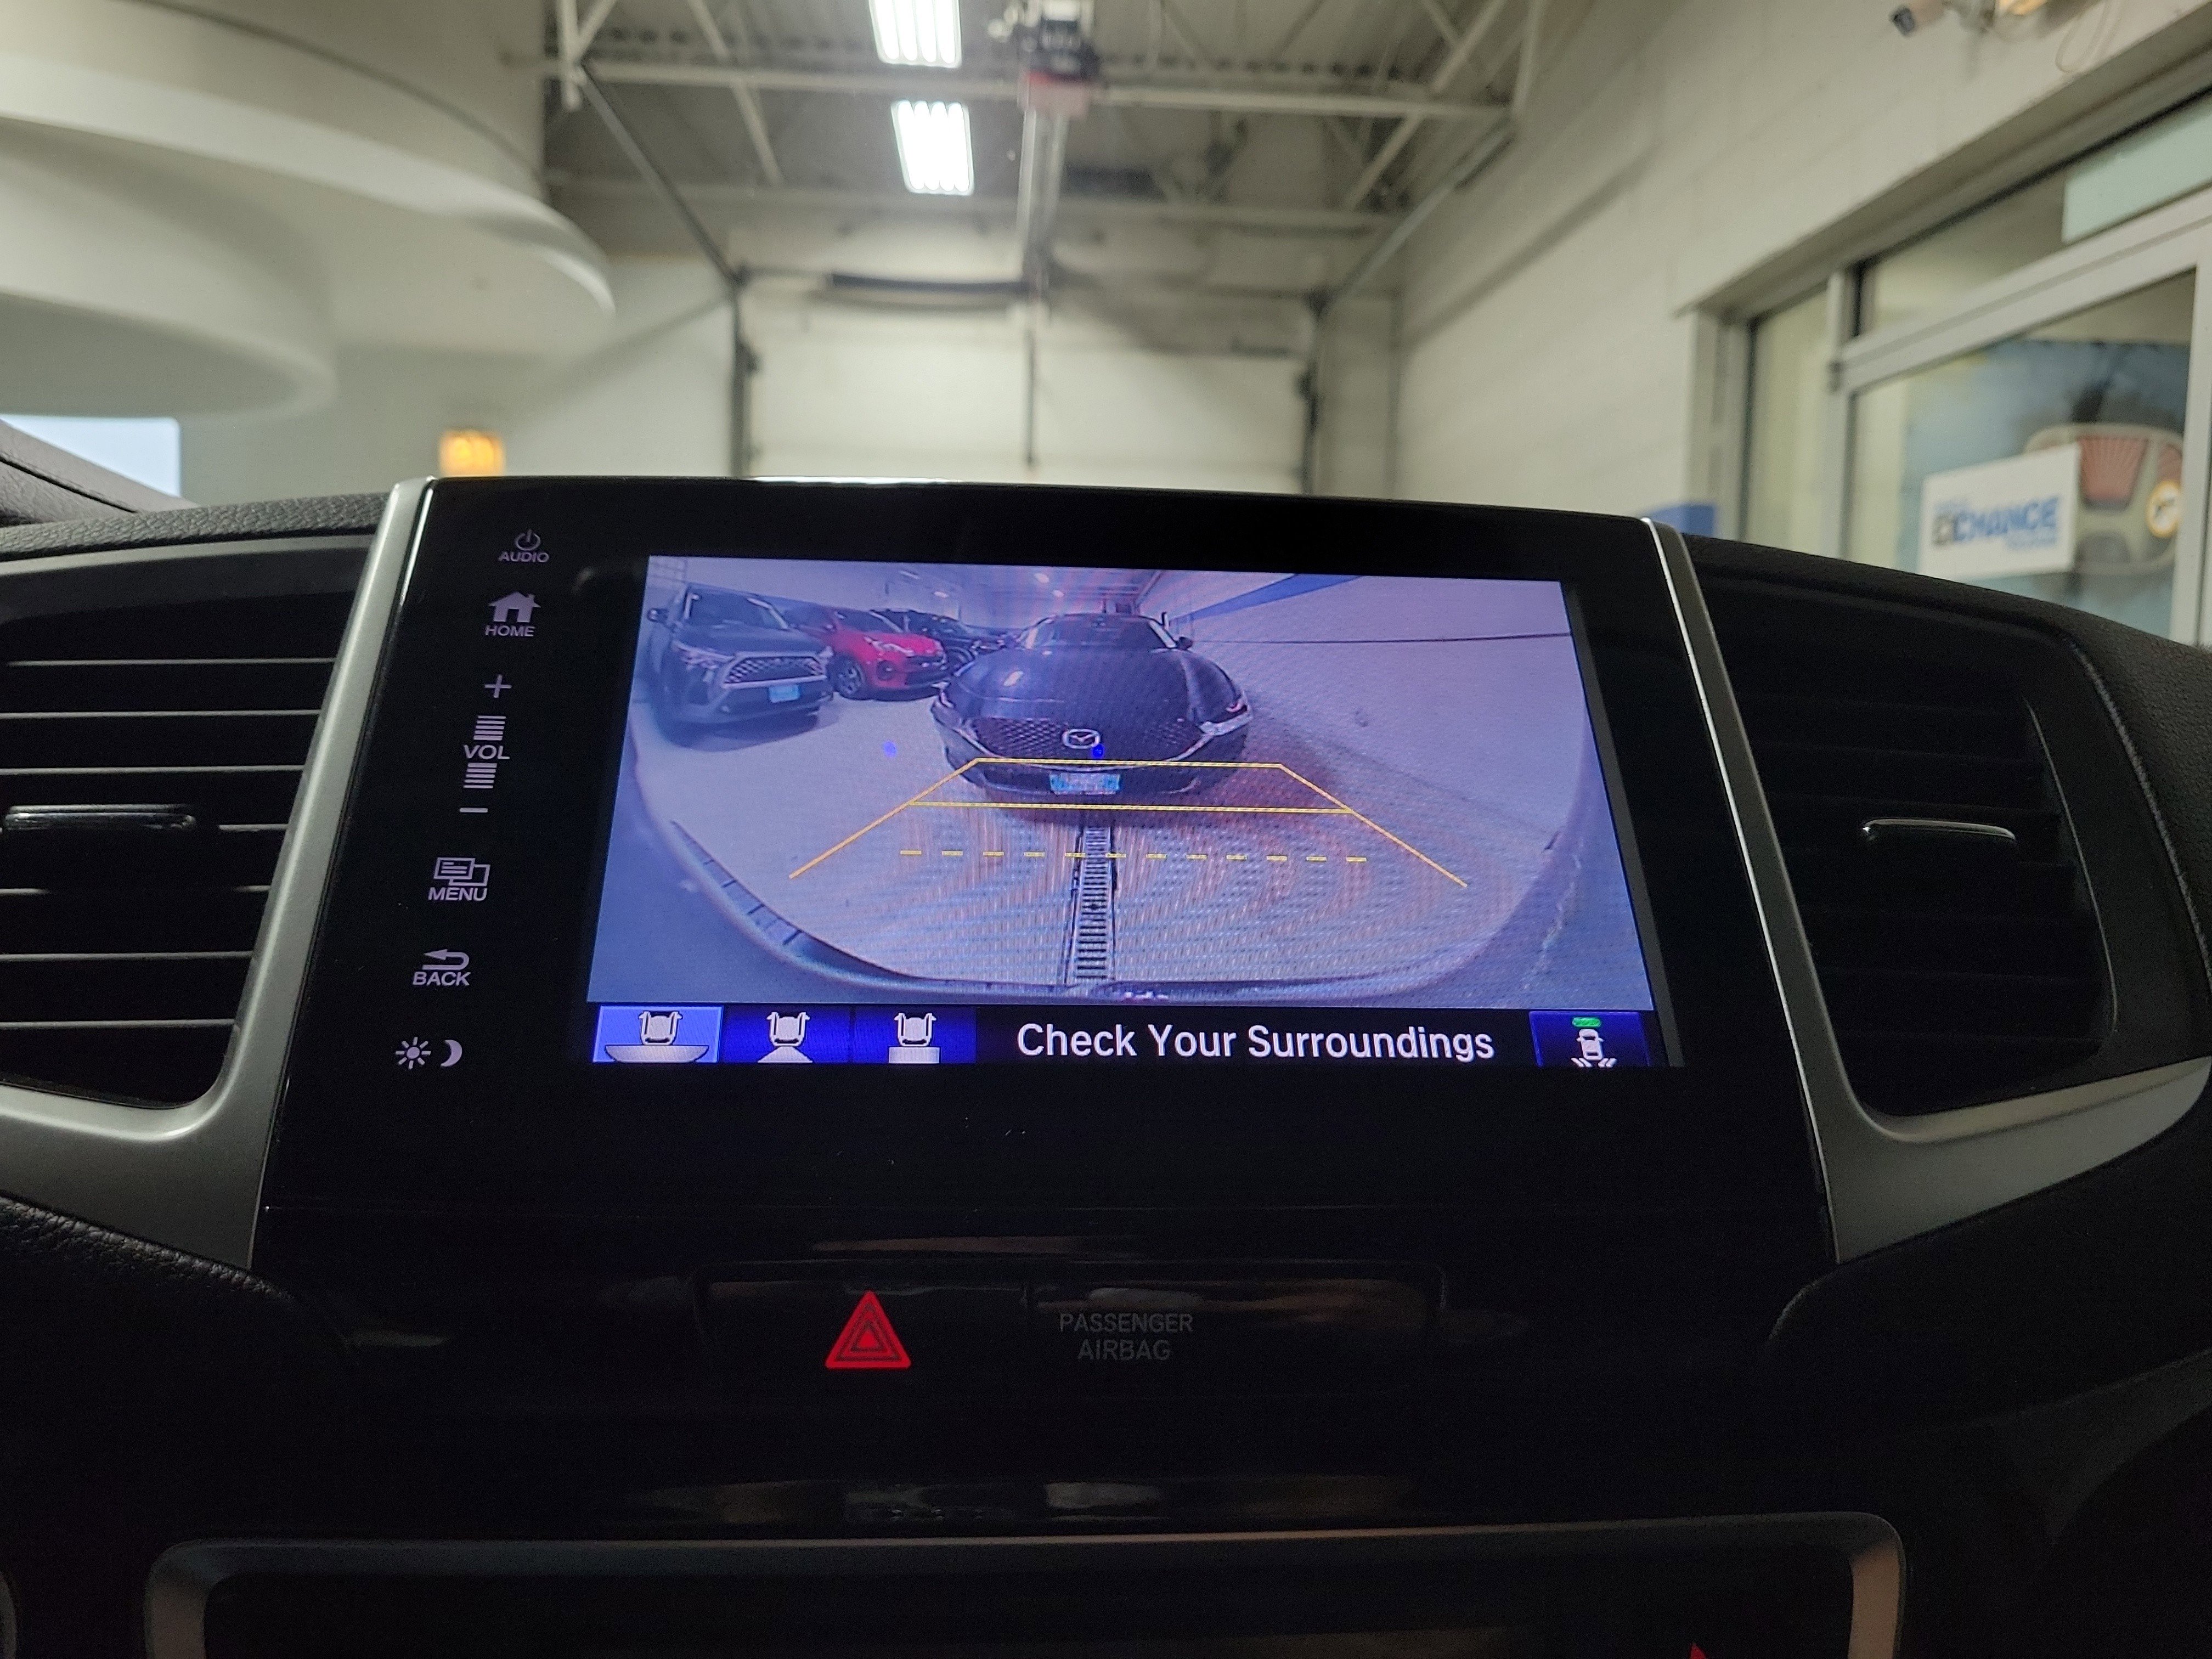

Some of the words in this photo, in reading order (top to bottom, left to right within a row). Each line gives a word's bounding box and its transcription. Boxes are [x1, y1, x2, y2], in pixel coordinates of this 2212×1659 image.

[499, 552, 549, 562] AUDIO
[485, 625, 535, 636] HOME
[464, 745, 510, 759] VOL
[428, 887, 488, 901] MENU
[413, 972, 471, 986] BACK
[1017, 1023, 1136, 1056] Check
[1148, 1024, 1237, 1057] Your
[1249, 1025, 1494, 1062] Surroundings
[1059, 1313, 1193, 1333] PASSENGER
[1077, 1339, 1171, 1361] AIRBAG
